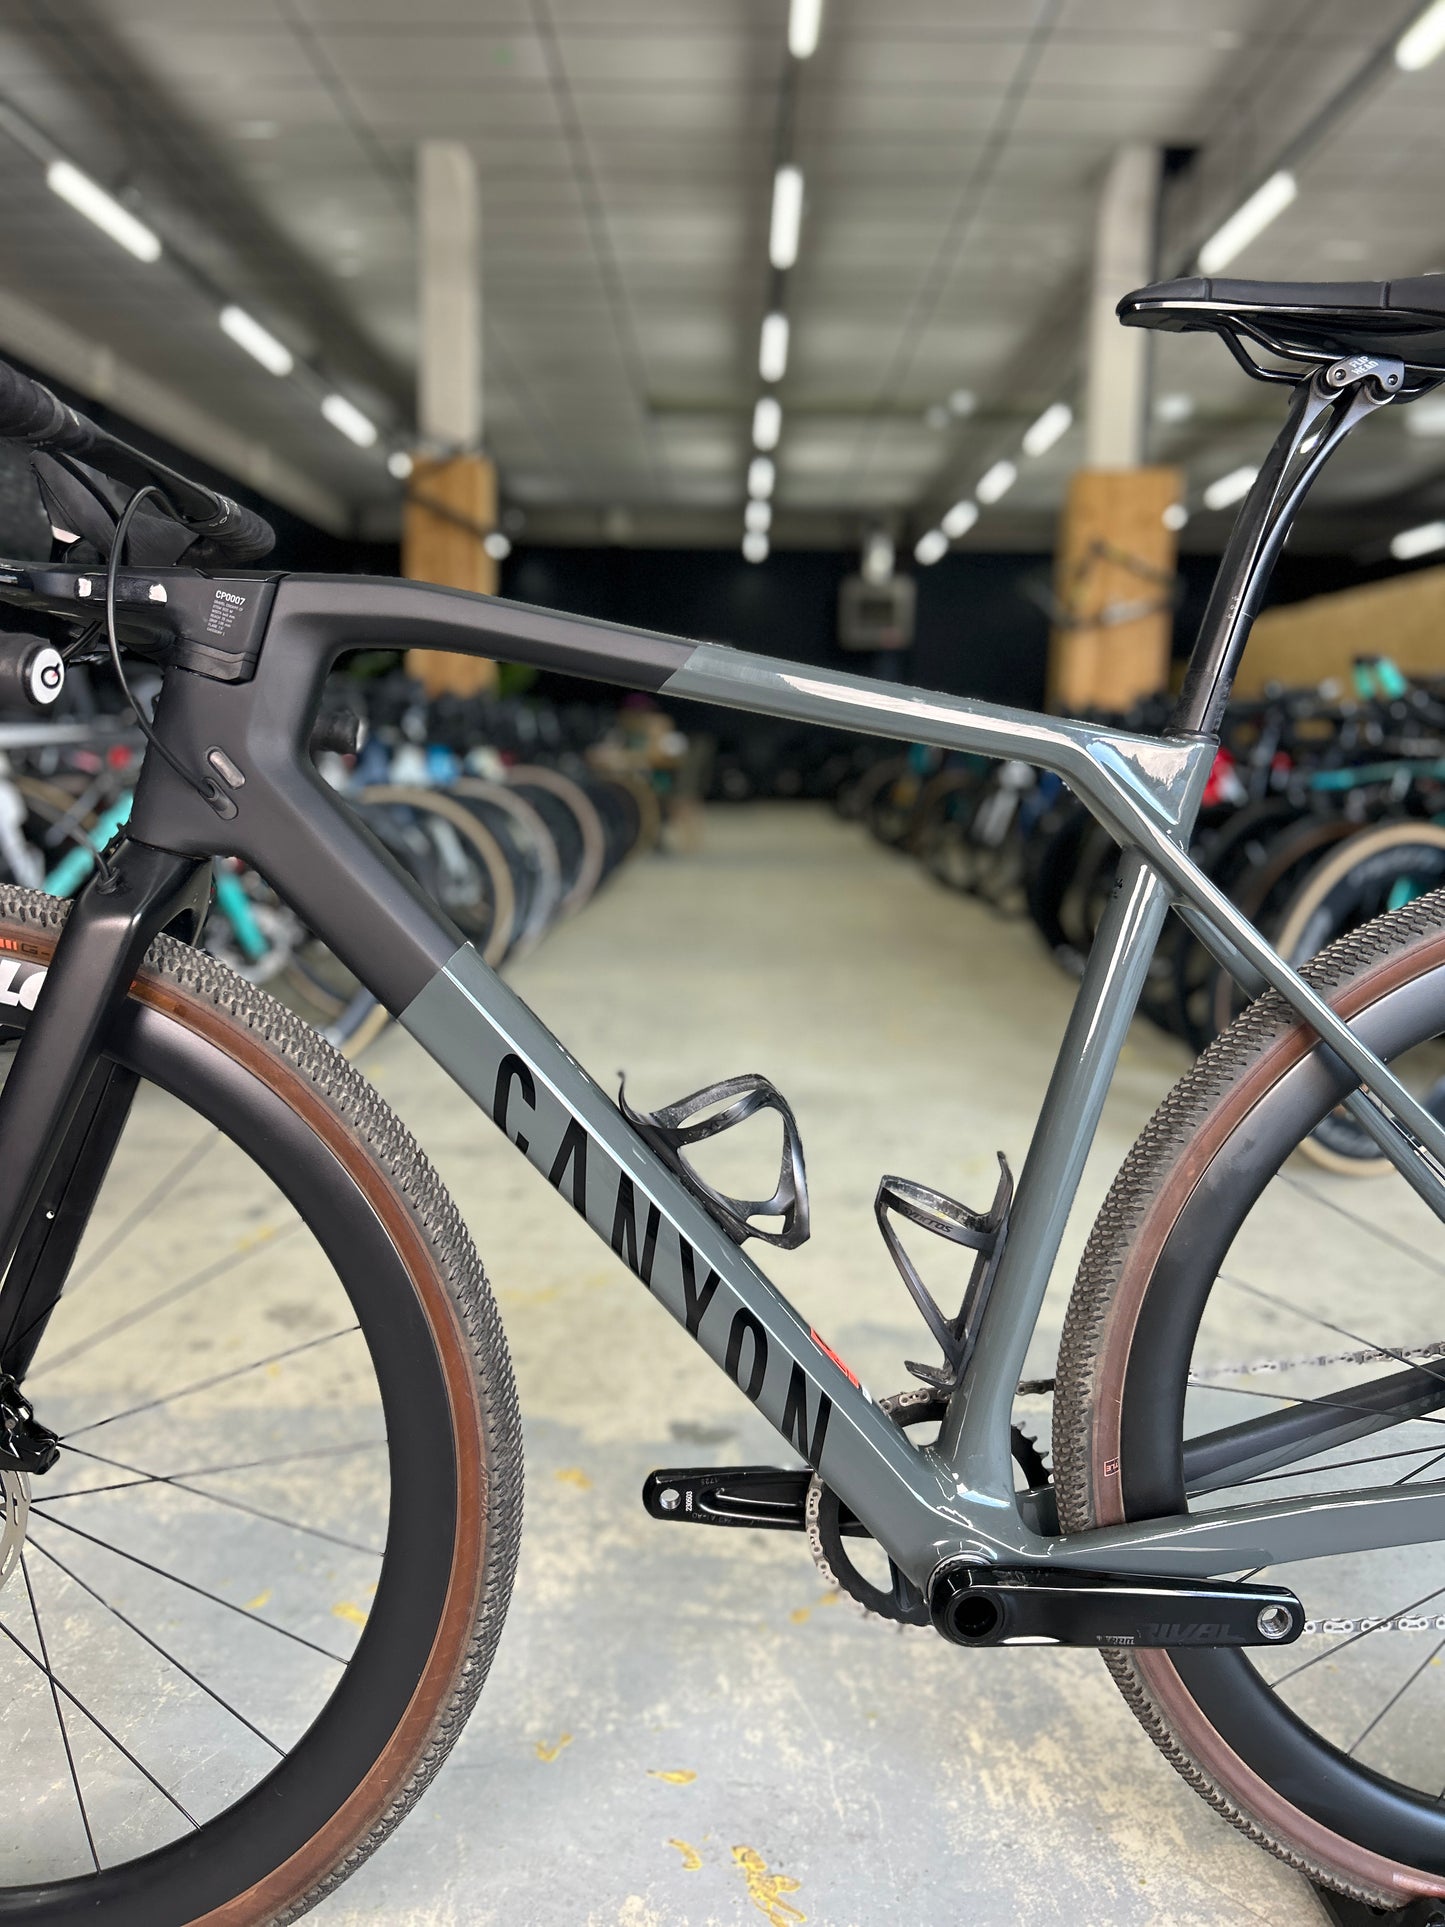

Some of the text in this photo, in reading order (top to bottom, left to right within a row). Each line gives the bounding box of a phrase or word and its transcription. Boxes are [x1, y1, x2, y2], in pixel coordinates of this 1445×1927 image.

[1348, 355, 1369, 368] FLIP
[1351, 360, 1379, 375] HEAD
[215, 590, 246, 606] CP0007
[903, 1205, 954, 1234] SYNCROS
[492, 1053, 833, 1471] CANYON
[1142, 1622, 1248, 1643] RIVAL
